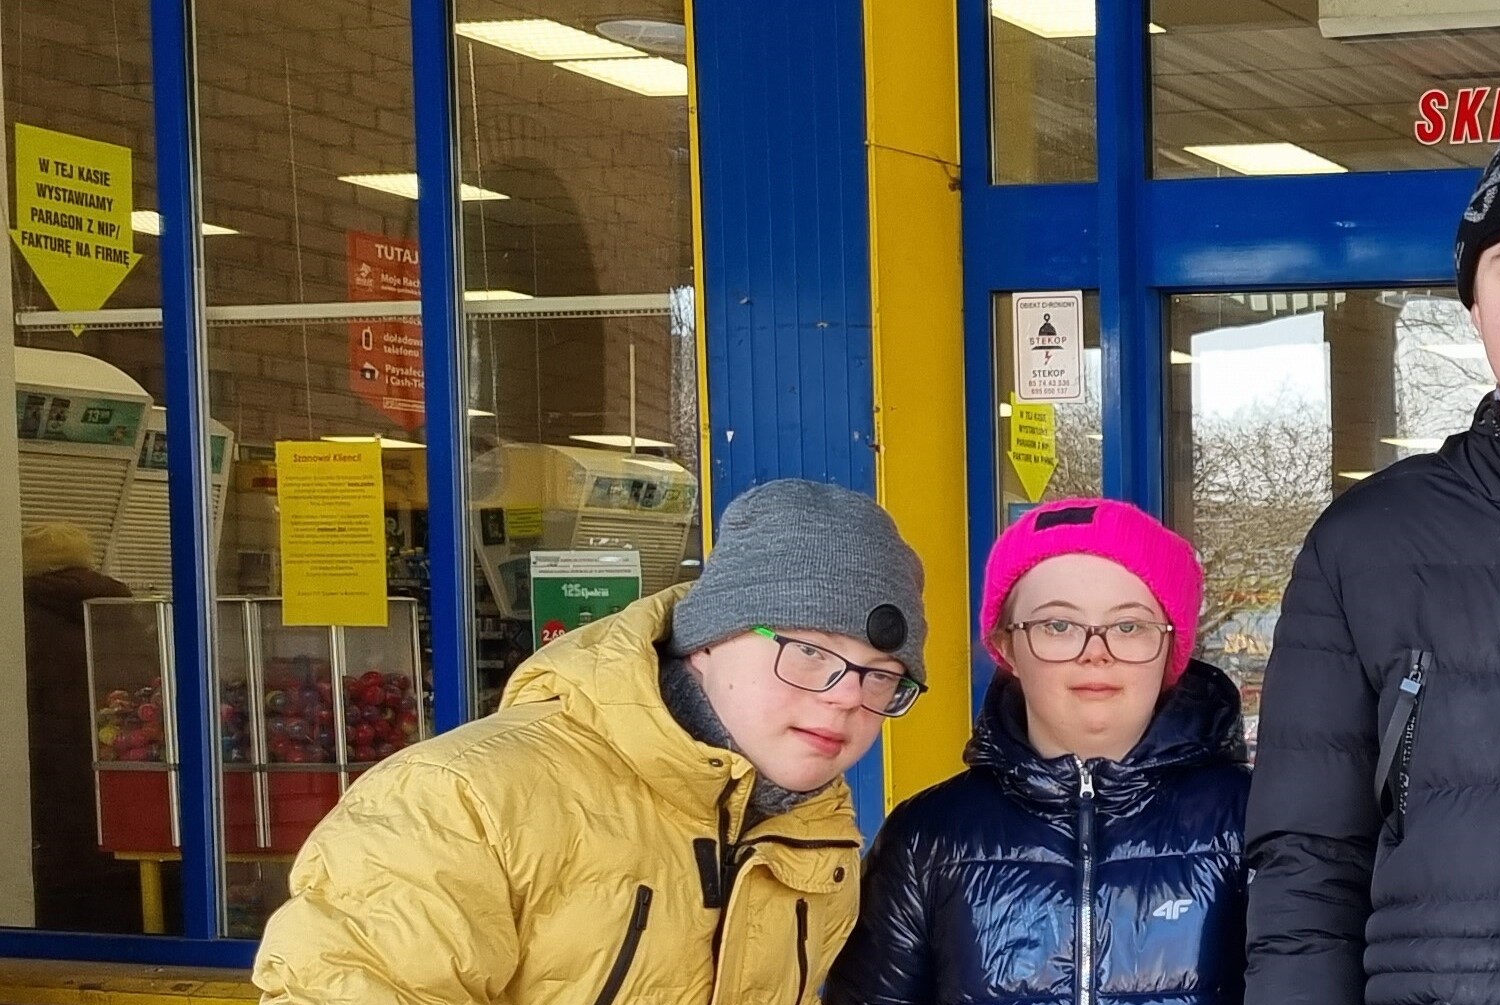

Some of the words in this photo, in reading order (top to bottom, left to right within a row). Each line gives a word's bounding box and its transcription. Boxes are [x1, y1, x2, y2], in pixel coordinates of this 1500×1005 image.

[38, 157, 50, 173] W
[54, 160, 74, 179] TEJ
[77, 166, 111, 187] KASIE
[35, 182, 114, 212] WYSTAWIAMY
[30, 207, 83, 231] PARAGON
[87, 219, 94, 233] Z
[97, 220, 120, 240] NIP/
[21, 231, 72, 258] FAKTURĘ
[75, 241, 91, 257] NA
[95, 245, 130, 269] FIRMĘ
[375, 244, 420, 265] TUTAJ
[1029, 336, 1067, 346] STEKOP
[1032, 369, 1066, 378] STEKOP
[1152, 898, 1193, 920] 4F
